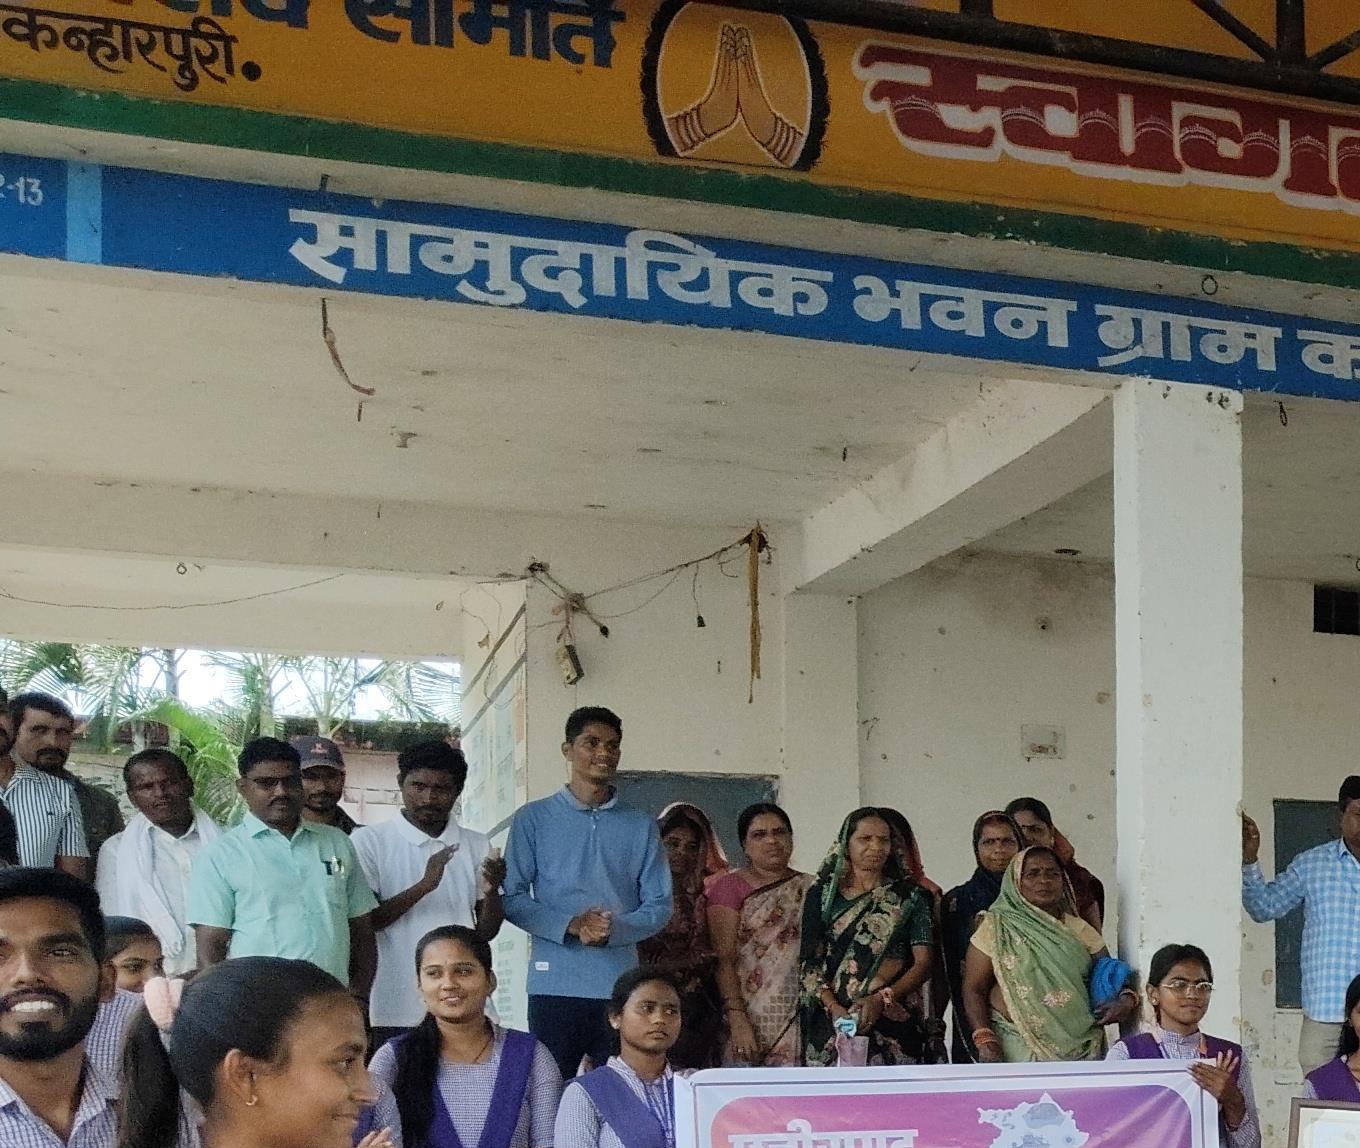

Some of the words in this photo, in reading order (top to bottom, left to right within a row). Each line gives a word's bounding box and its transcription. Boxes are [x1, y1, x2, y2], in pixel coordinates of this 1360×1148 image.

[289, 207, 834, 310] सामुदायिक
[852, 274, 1077, 348] भवन
[1096, 303, 1284, 372] ग्राम
